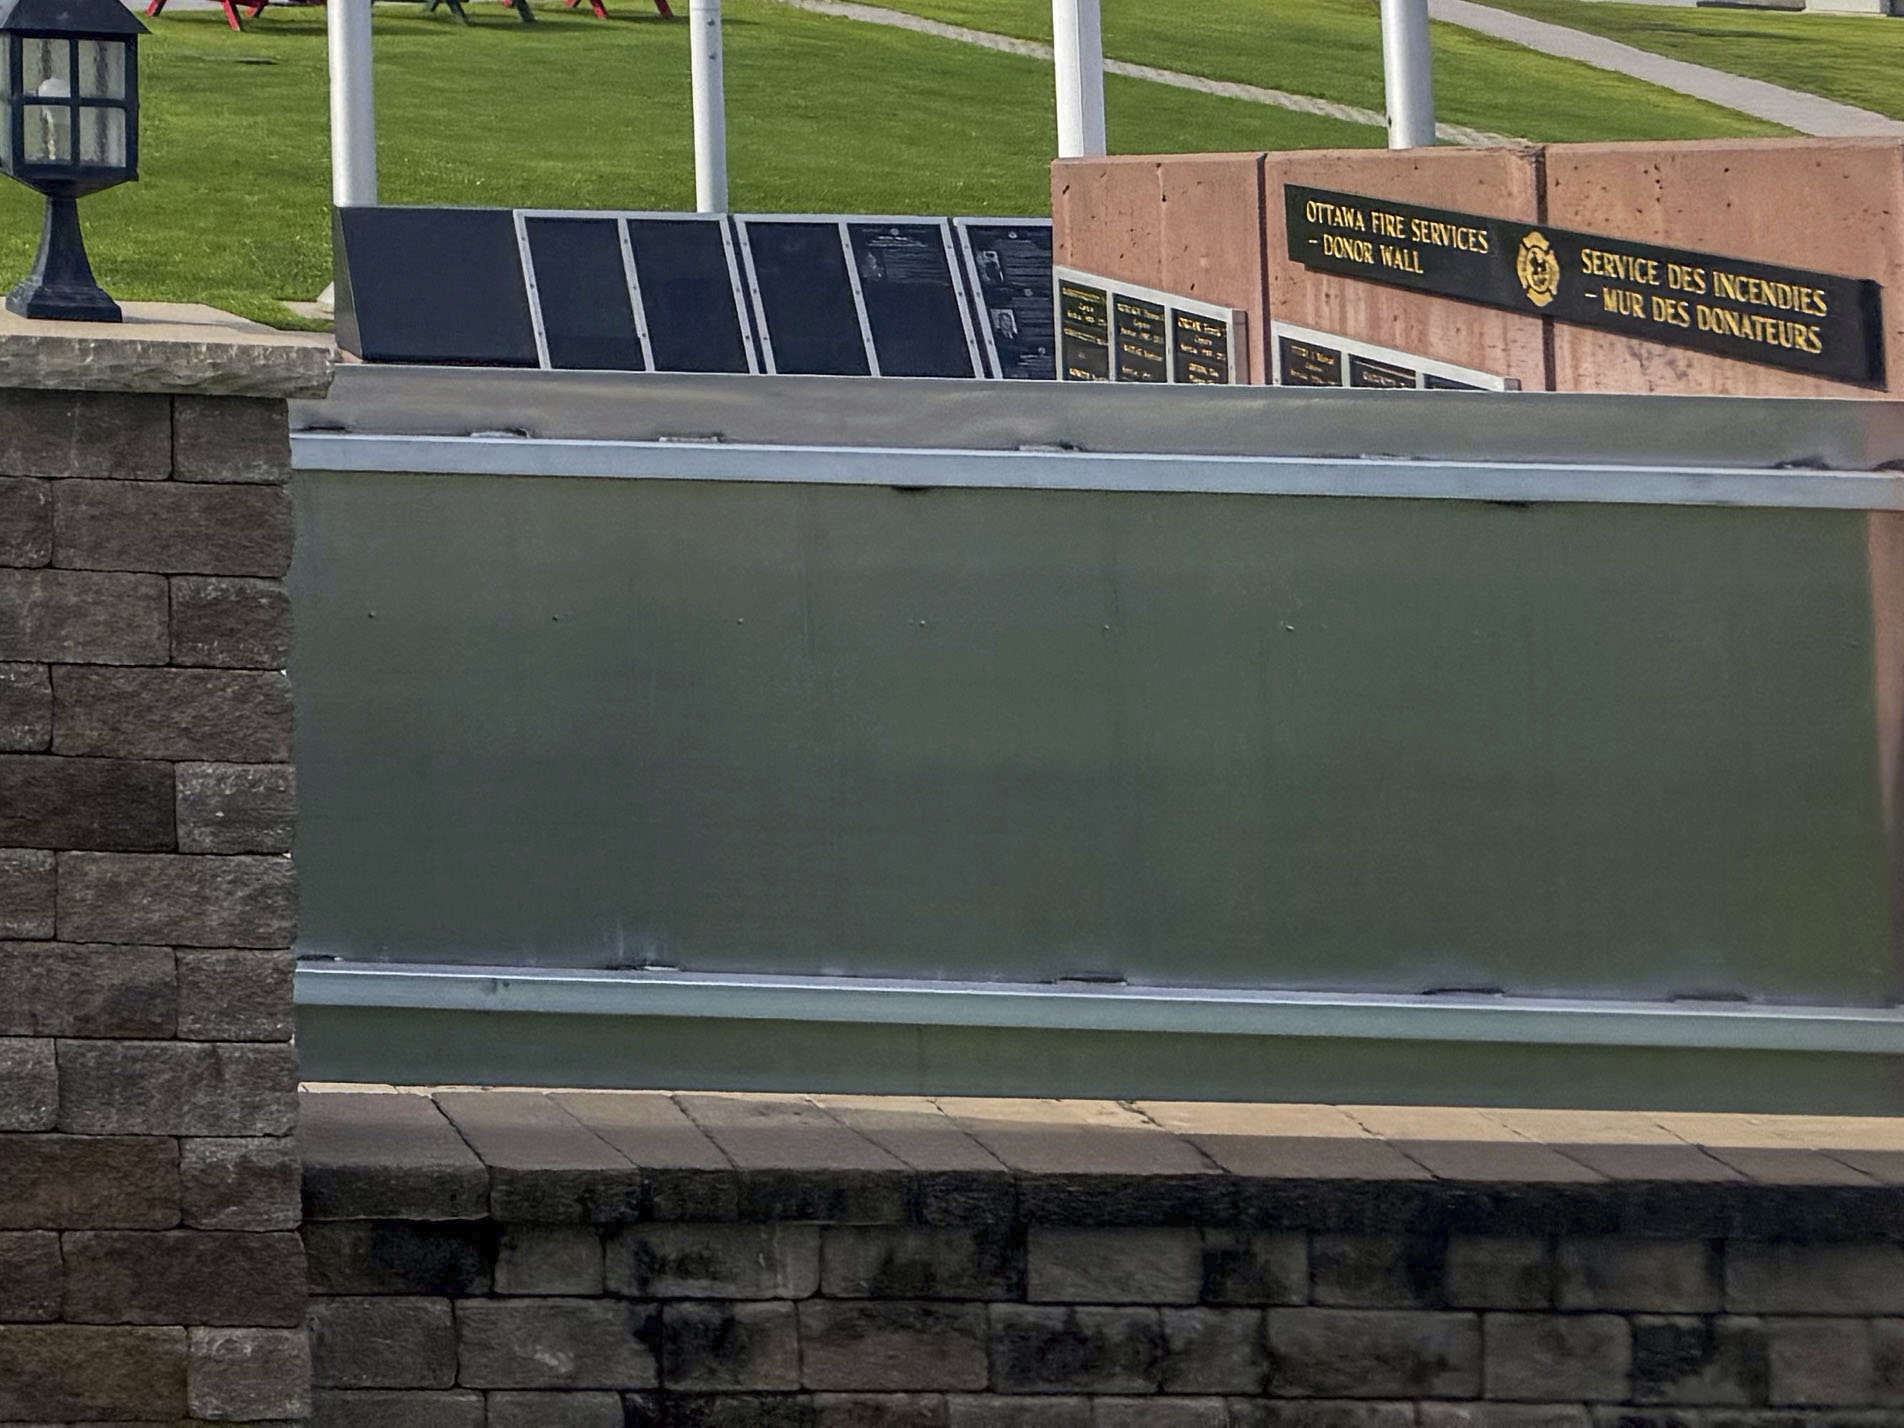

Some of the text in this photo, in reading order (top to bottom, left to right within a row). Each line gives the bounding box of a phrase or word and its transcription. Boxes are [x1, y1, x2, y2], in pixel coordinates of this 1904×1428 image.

[1306, 200, 1489, 254] OTTAWA FIRE SERVICES
[1323, 234, 1375, 264] DONOR
[1379, 244, 1424, 274] WALL
[1581, 248, 1828, 317] SERVICE DES INCENDIES
[1603, 286, 1646, 319] MUR
[1652, 296, 1690, 328] DES
[1696, 305, 1823, 355] DONATEURS
